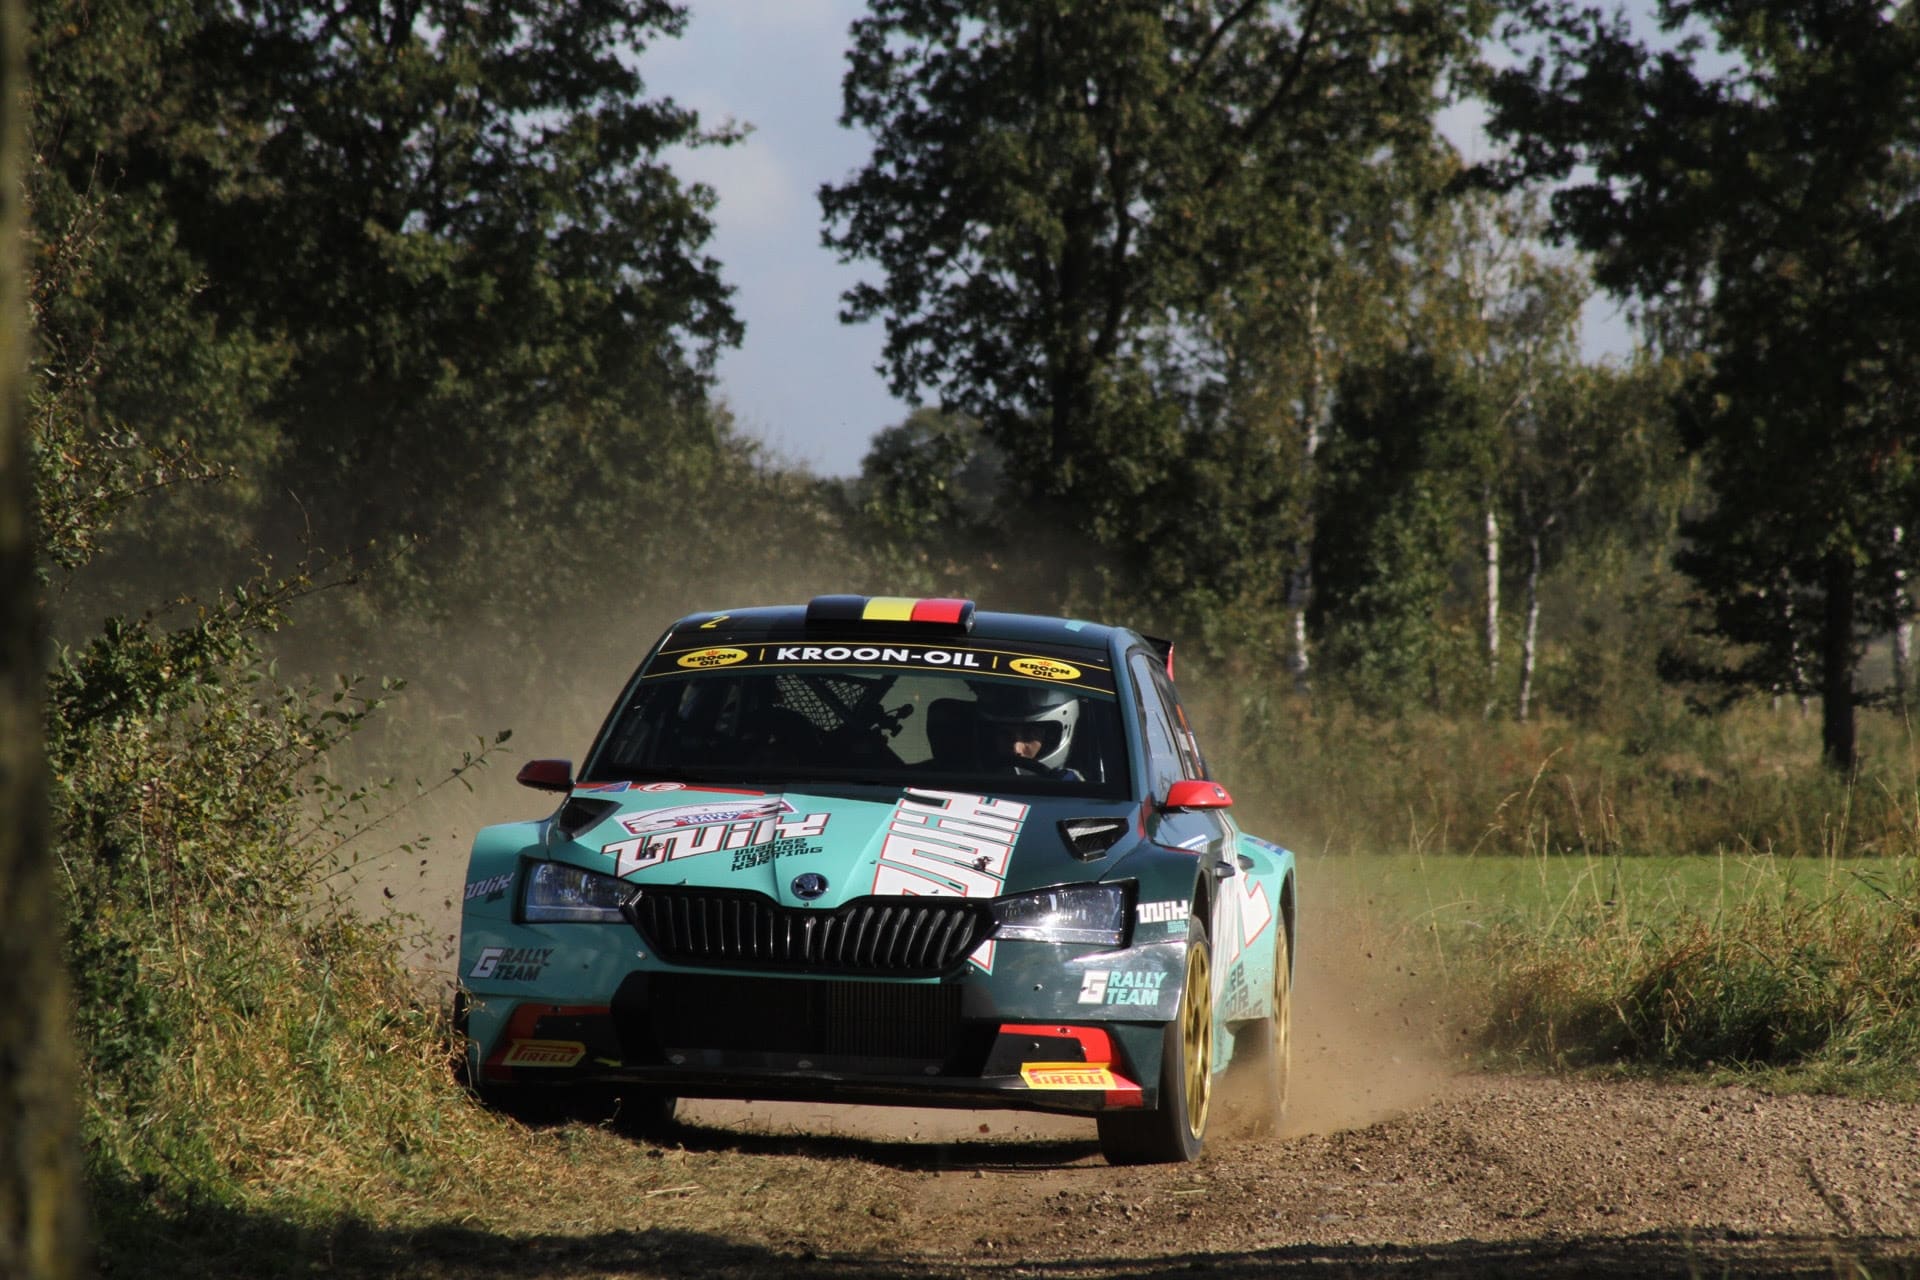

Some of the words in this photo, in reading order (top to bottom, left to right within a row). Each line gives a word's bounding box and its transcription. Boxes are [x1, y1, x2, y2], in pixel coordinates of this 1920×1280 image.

[687, 653, 738, 663] KROON
[776, 647, 980, 667] KROON-OIL
[1019, 663, 1070, 675] KROON
[1032, 670, 1054, 678] OIL
[500, 948, 555, 964] RALLY
[495, 964, 542, 980] TEAM
[1108, 971, 1168, 989] RALLY
[1106, 988, 1160, 1005] TEAM
[511, 1045, 580, 1063] PIRELLI
[1028, 1068, 1106, 1085] PIRELLI
